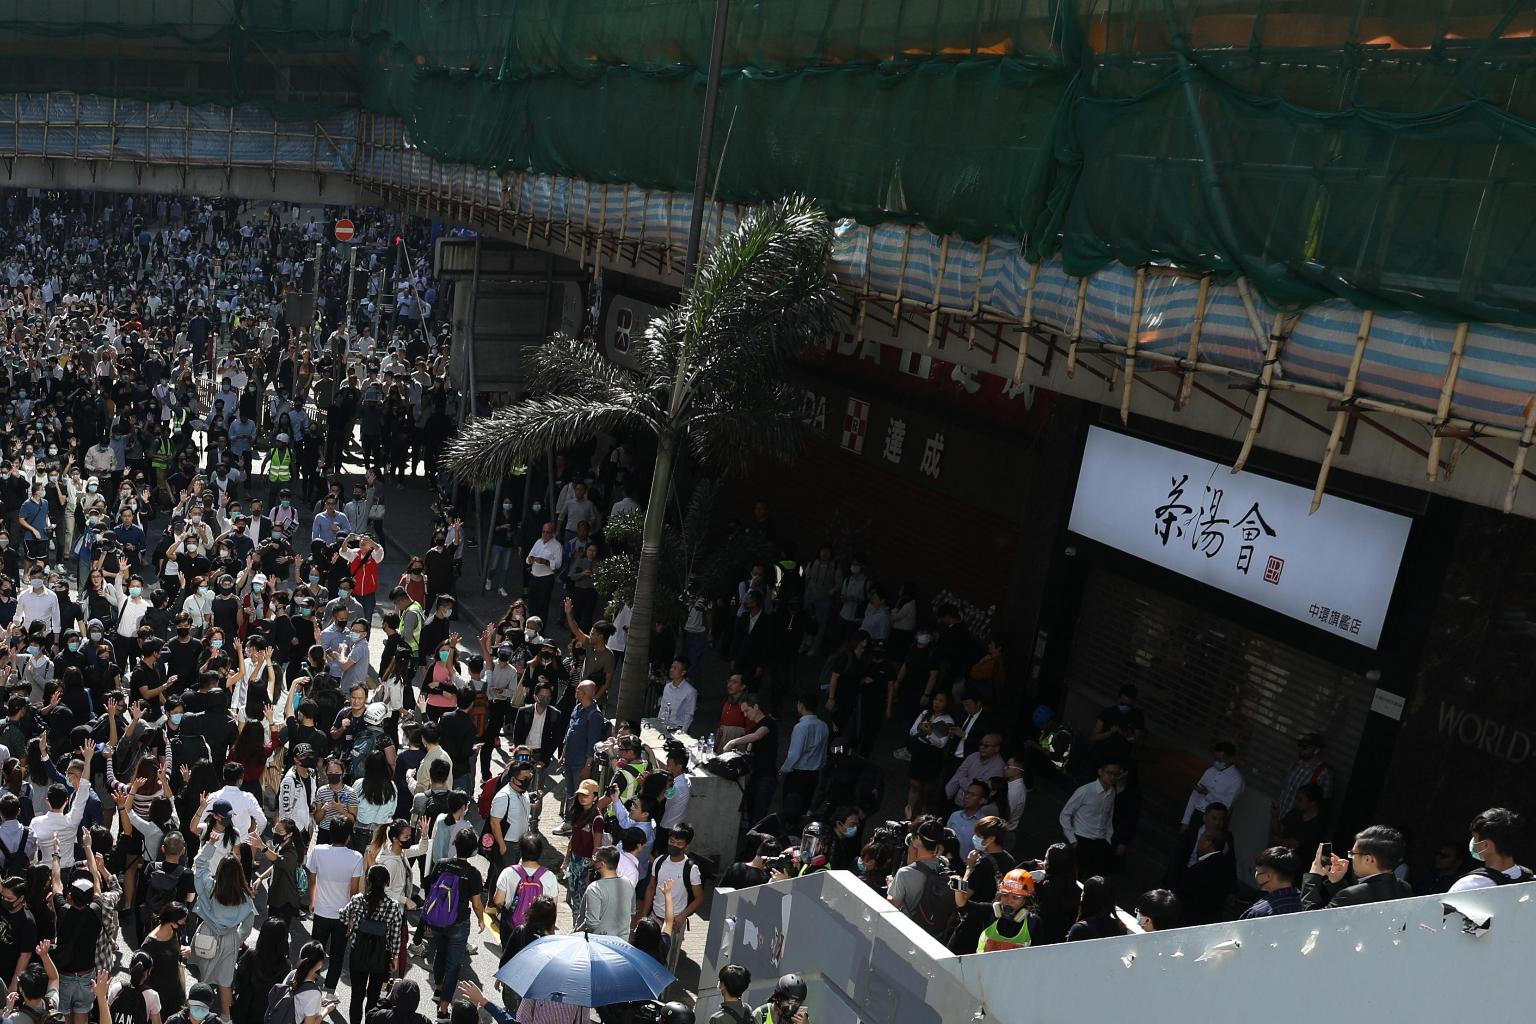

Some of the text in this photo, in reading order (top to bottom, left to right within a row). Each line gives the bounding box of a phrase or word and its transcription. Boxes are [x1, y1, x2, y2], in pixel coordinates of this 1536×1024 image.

[881, 415, 947, 480] 達成
[1152, 474, 1277, 576] 茶湯會
[1308, 601, 1362, 636] 中環旗艦店
